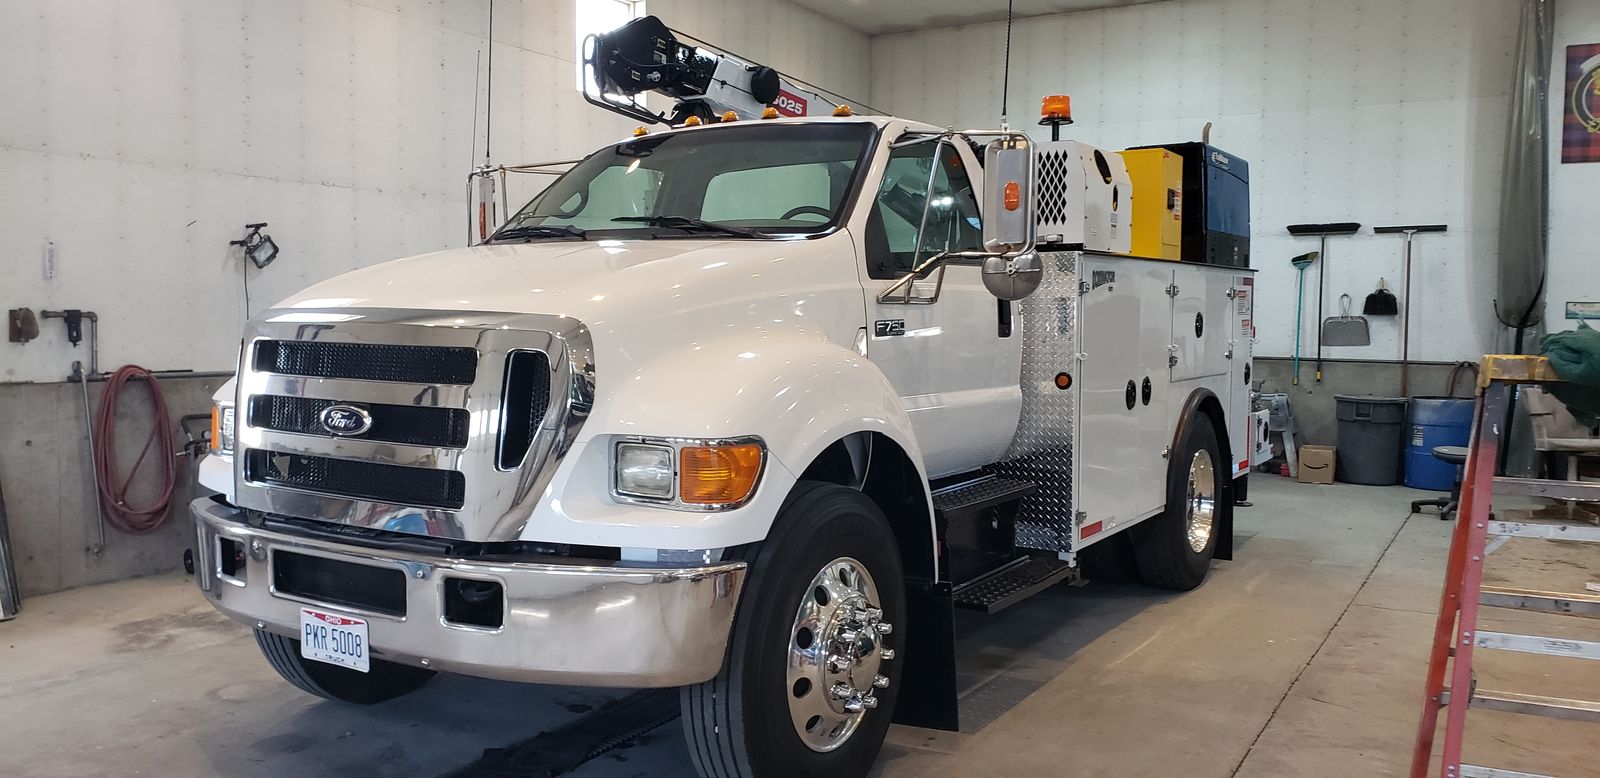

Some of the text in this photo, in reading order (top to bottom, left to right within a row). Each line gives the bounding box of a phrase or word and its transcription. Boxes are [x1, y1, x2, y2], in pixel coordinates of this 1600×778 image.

[876, 320, 905, 333] F750
[328, 410, 356, 428] Ford
[325, 615, 342, 625] OHIO
[305, 623, 362, 658] PKR 5008
